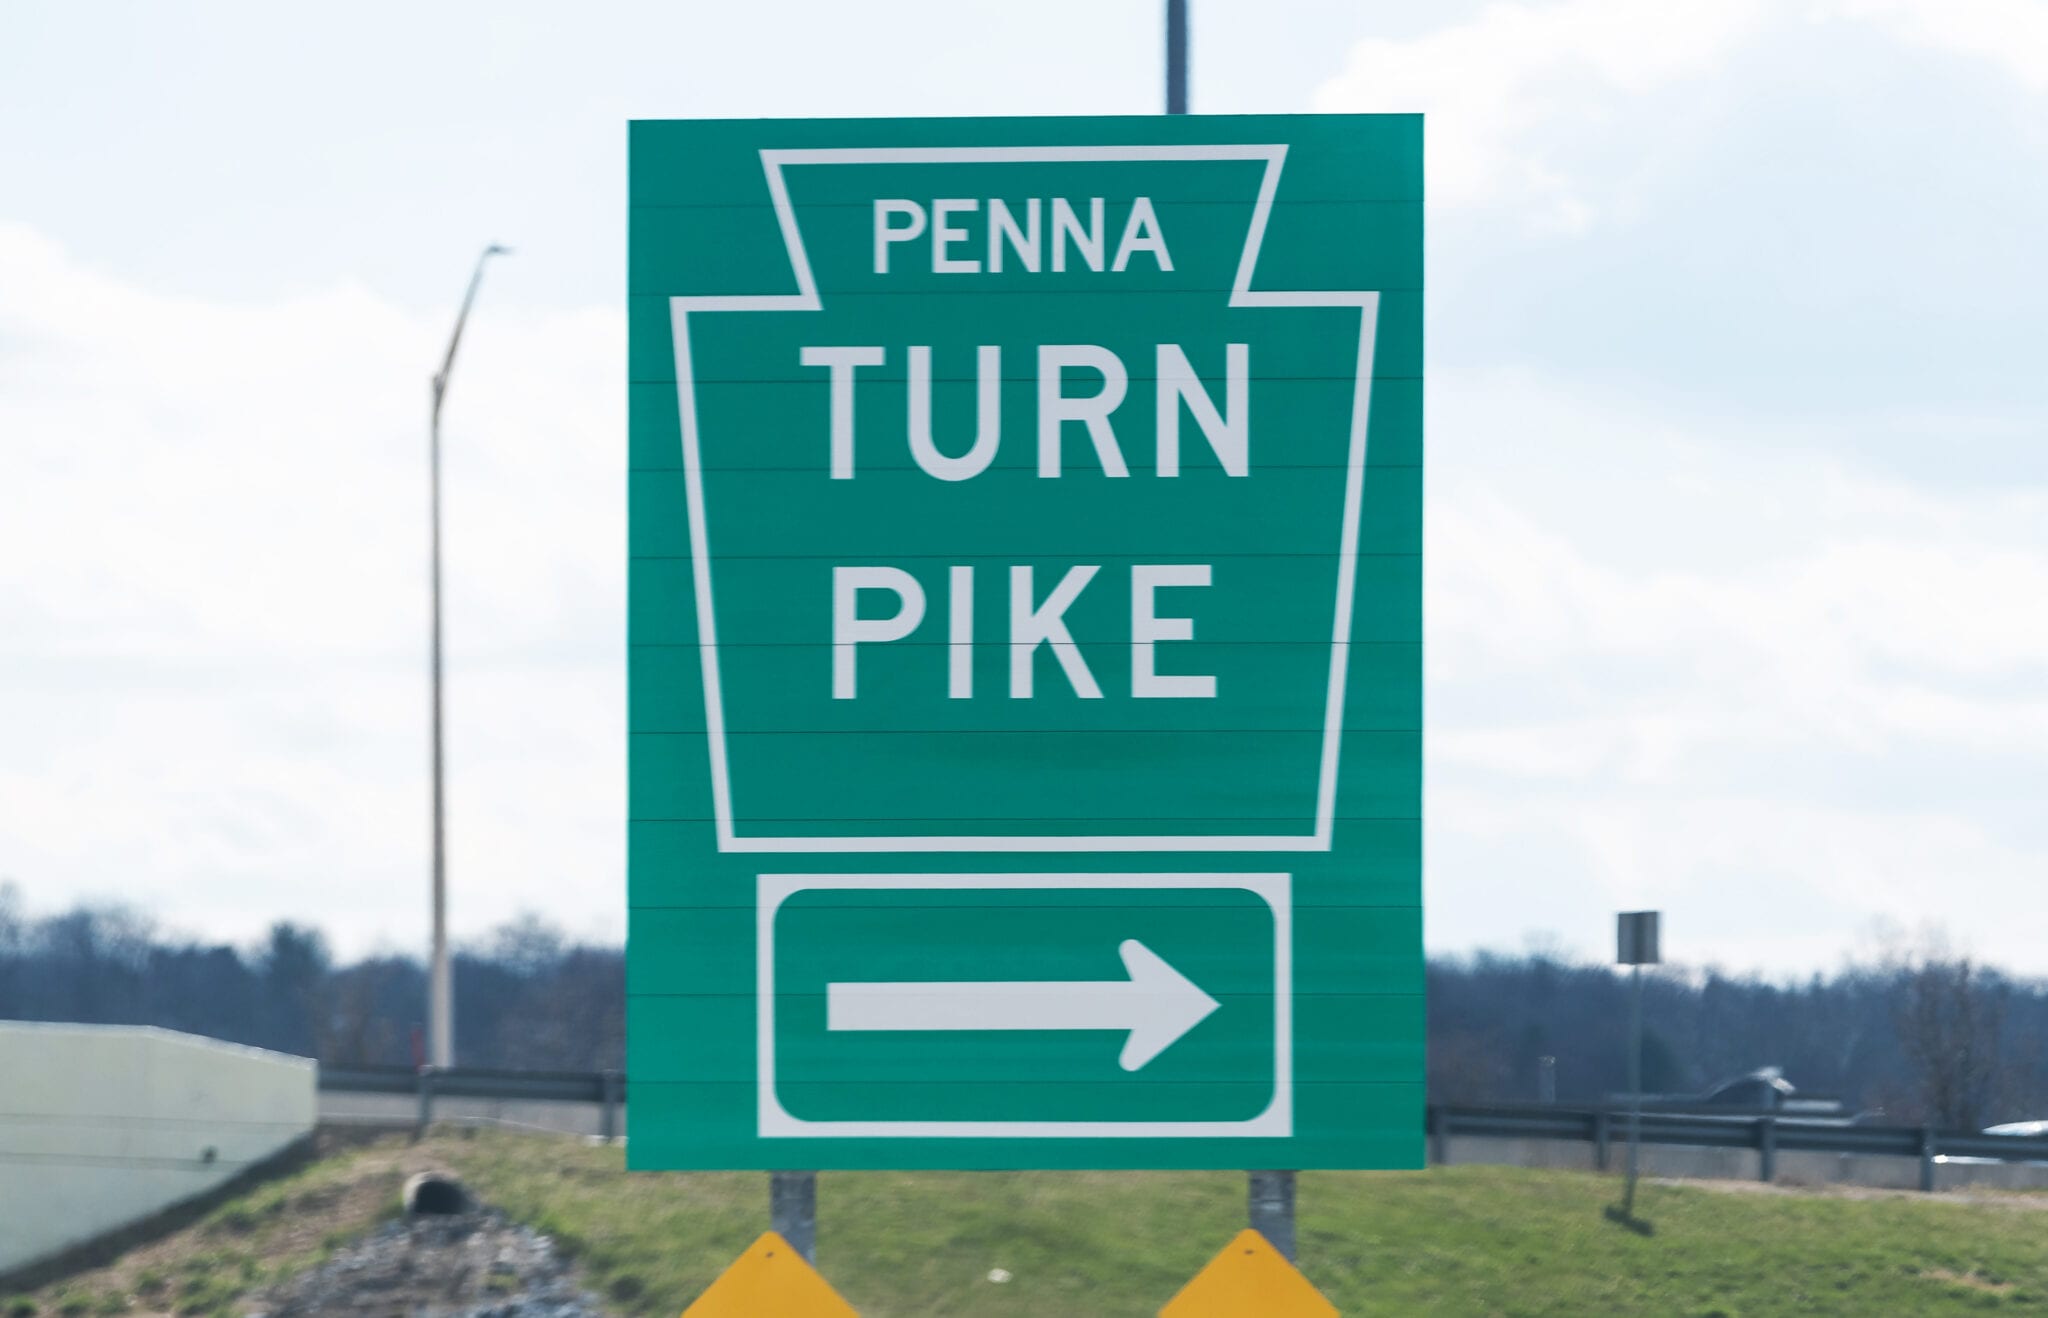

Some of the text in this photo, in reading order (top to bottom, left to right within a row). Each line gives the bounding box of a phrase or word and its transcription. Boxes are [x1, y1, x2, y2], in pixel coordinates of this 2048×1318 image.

[872, 197, 1175, 274] PENNA
[800, 343, 1250, 481] TURN
[831, 564, 1218, 700] PIKE
